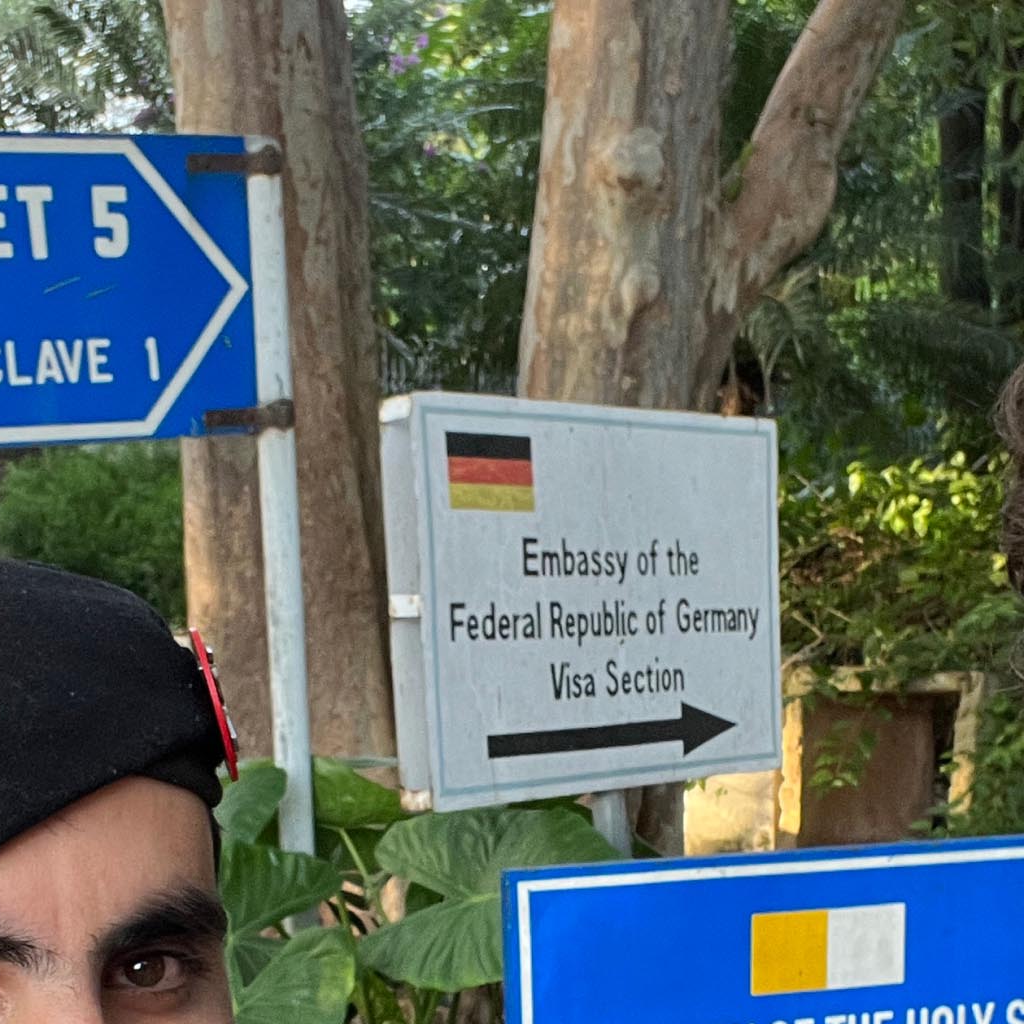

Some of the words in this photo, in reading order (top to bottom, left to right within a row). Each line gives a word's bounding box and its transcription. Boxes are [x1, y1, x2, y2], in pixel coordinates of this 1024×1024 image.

[91, 185, 129, 258] 5
[144, 337, 160, 381] 1
[522, 537, 628, 585] Embassy
[637, 539, 659, 576] of
[666, 540, 700, 576] the
[449, 601, 542, 642] Federal
[549, 600, 638, 647] Republic
[645, 598, 666, 635] of
[676, 598, 759, 640] Germany
[550, 661, 596, 701] Visa
[606, 657, 685, 697] Section
